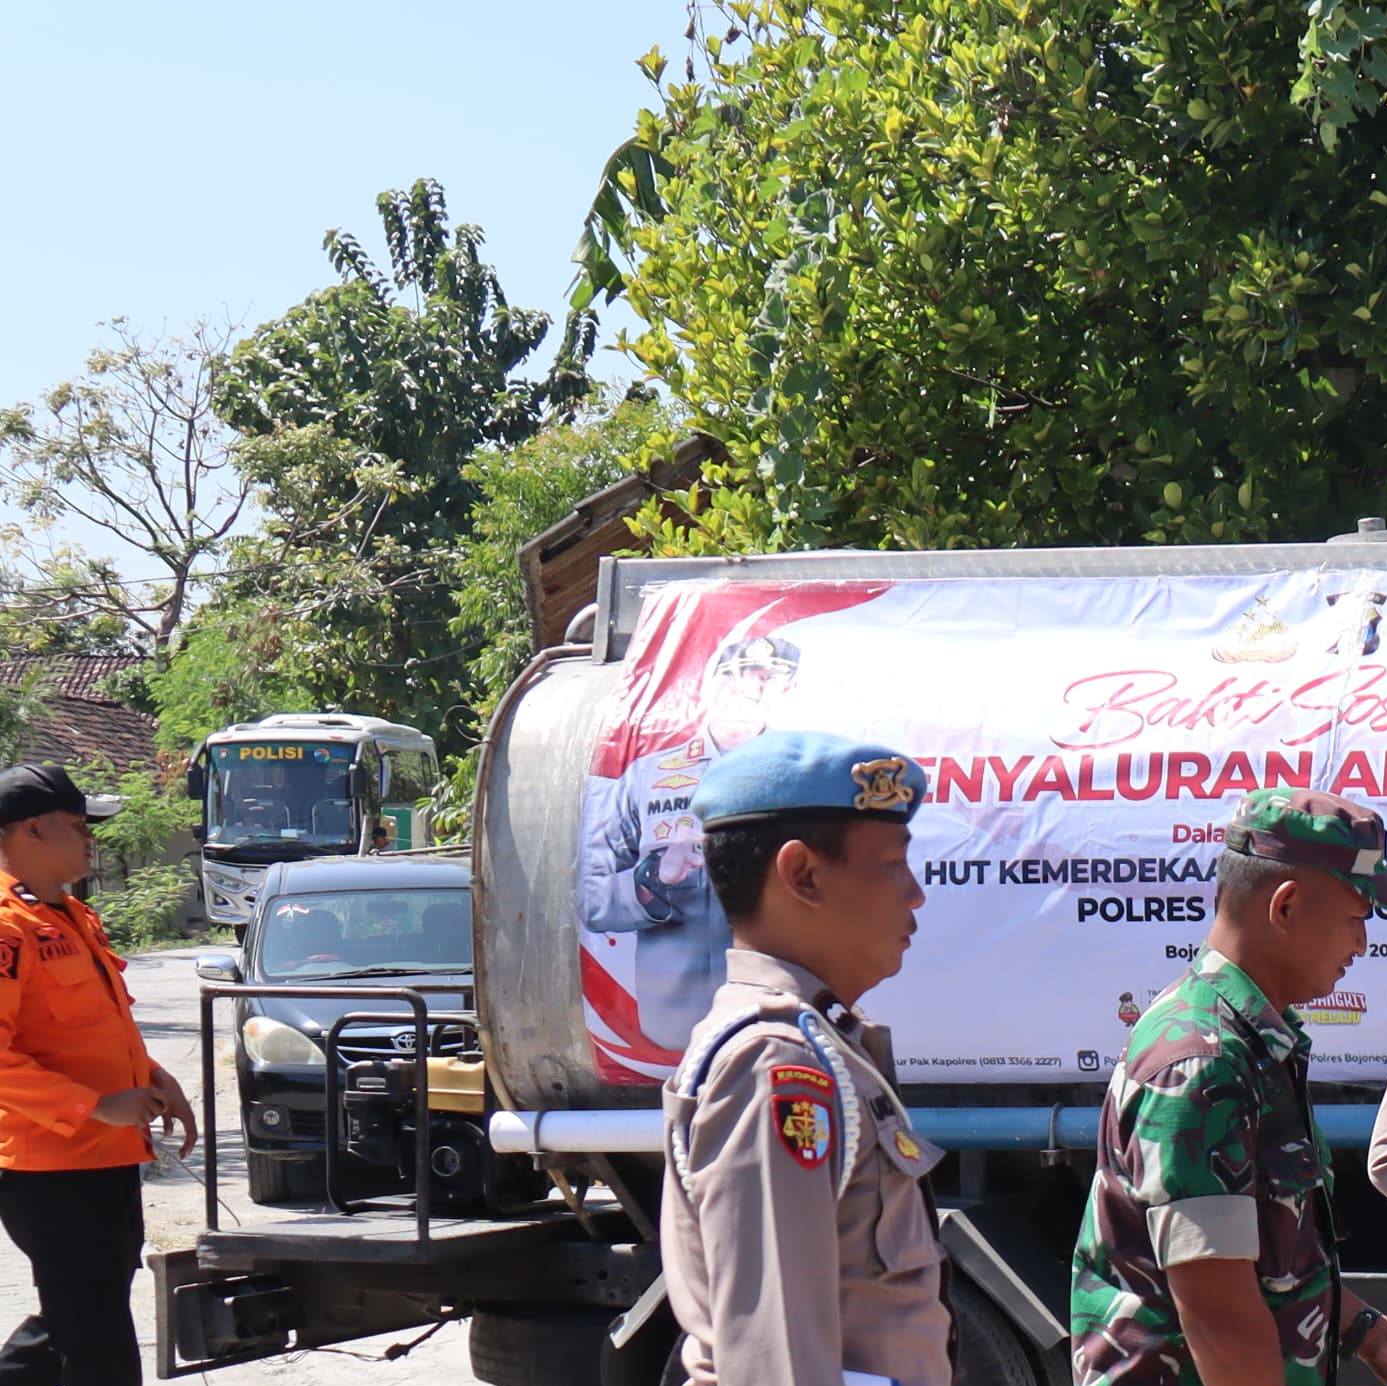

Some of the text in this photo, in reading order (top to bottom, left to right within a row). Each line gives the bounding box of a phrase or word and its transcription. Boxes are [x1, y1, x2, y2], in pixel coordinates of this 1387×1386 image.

[1049, 670, 1285, 751] Bakti
[240, 746, 303, 759] POLISI
[1172, 824, 1226, 844] Dala
[924, 860, 991, 885] HUT
[1000, 857, 1218, 884] KEMERDEKAA
[1077, 896, 1206, 923] POLRES
[1311, 1011, 1361, 1024] MELAJU
[910, 1057, 929, 1066] Pak
[932, 1056, 977, 1067] Kapolres
[979, 1056, 1006, 1067] (0813
[1008, 1056, 1033, 1066] 3366
[1035, 1056, 1062, 1067] 2227)
[1310, 1053, 1342, 1063] Polres
